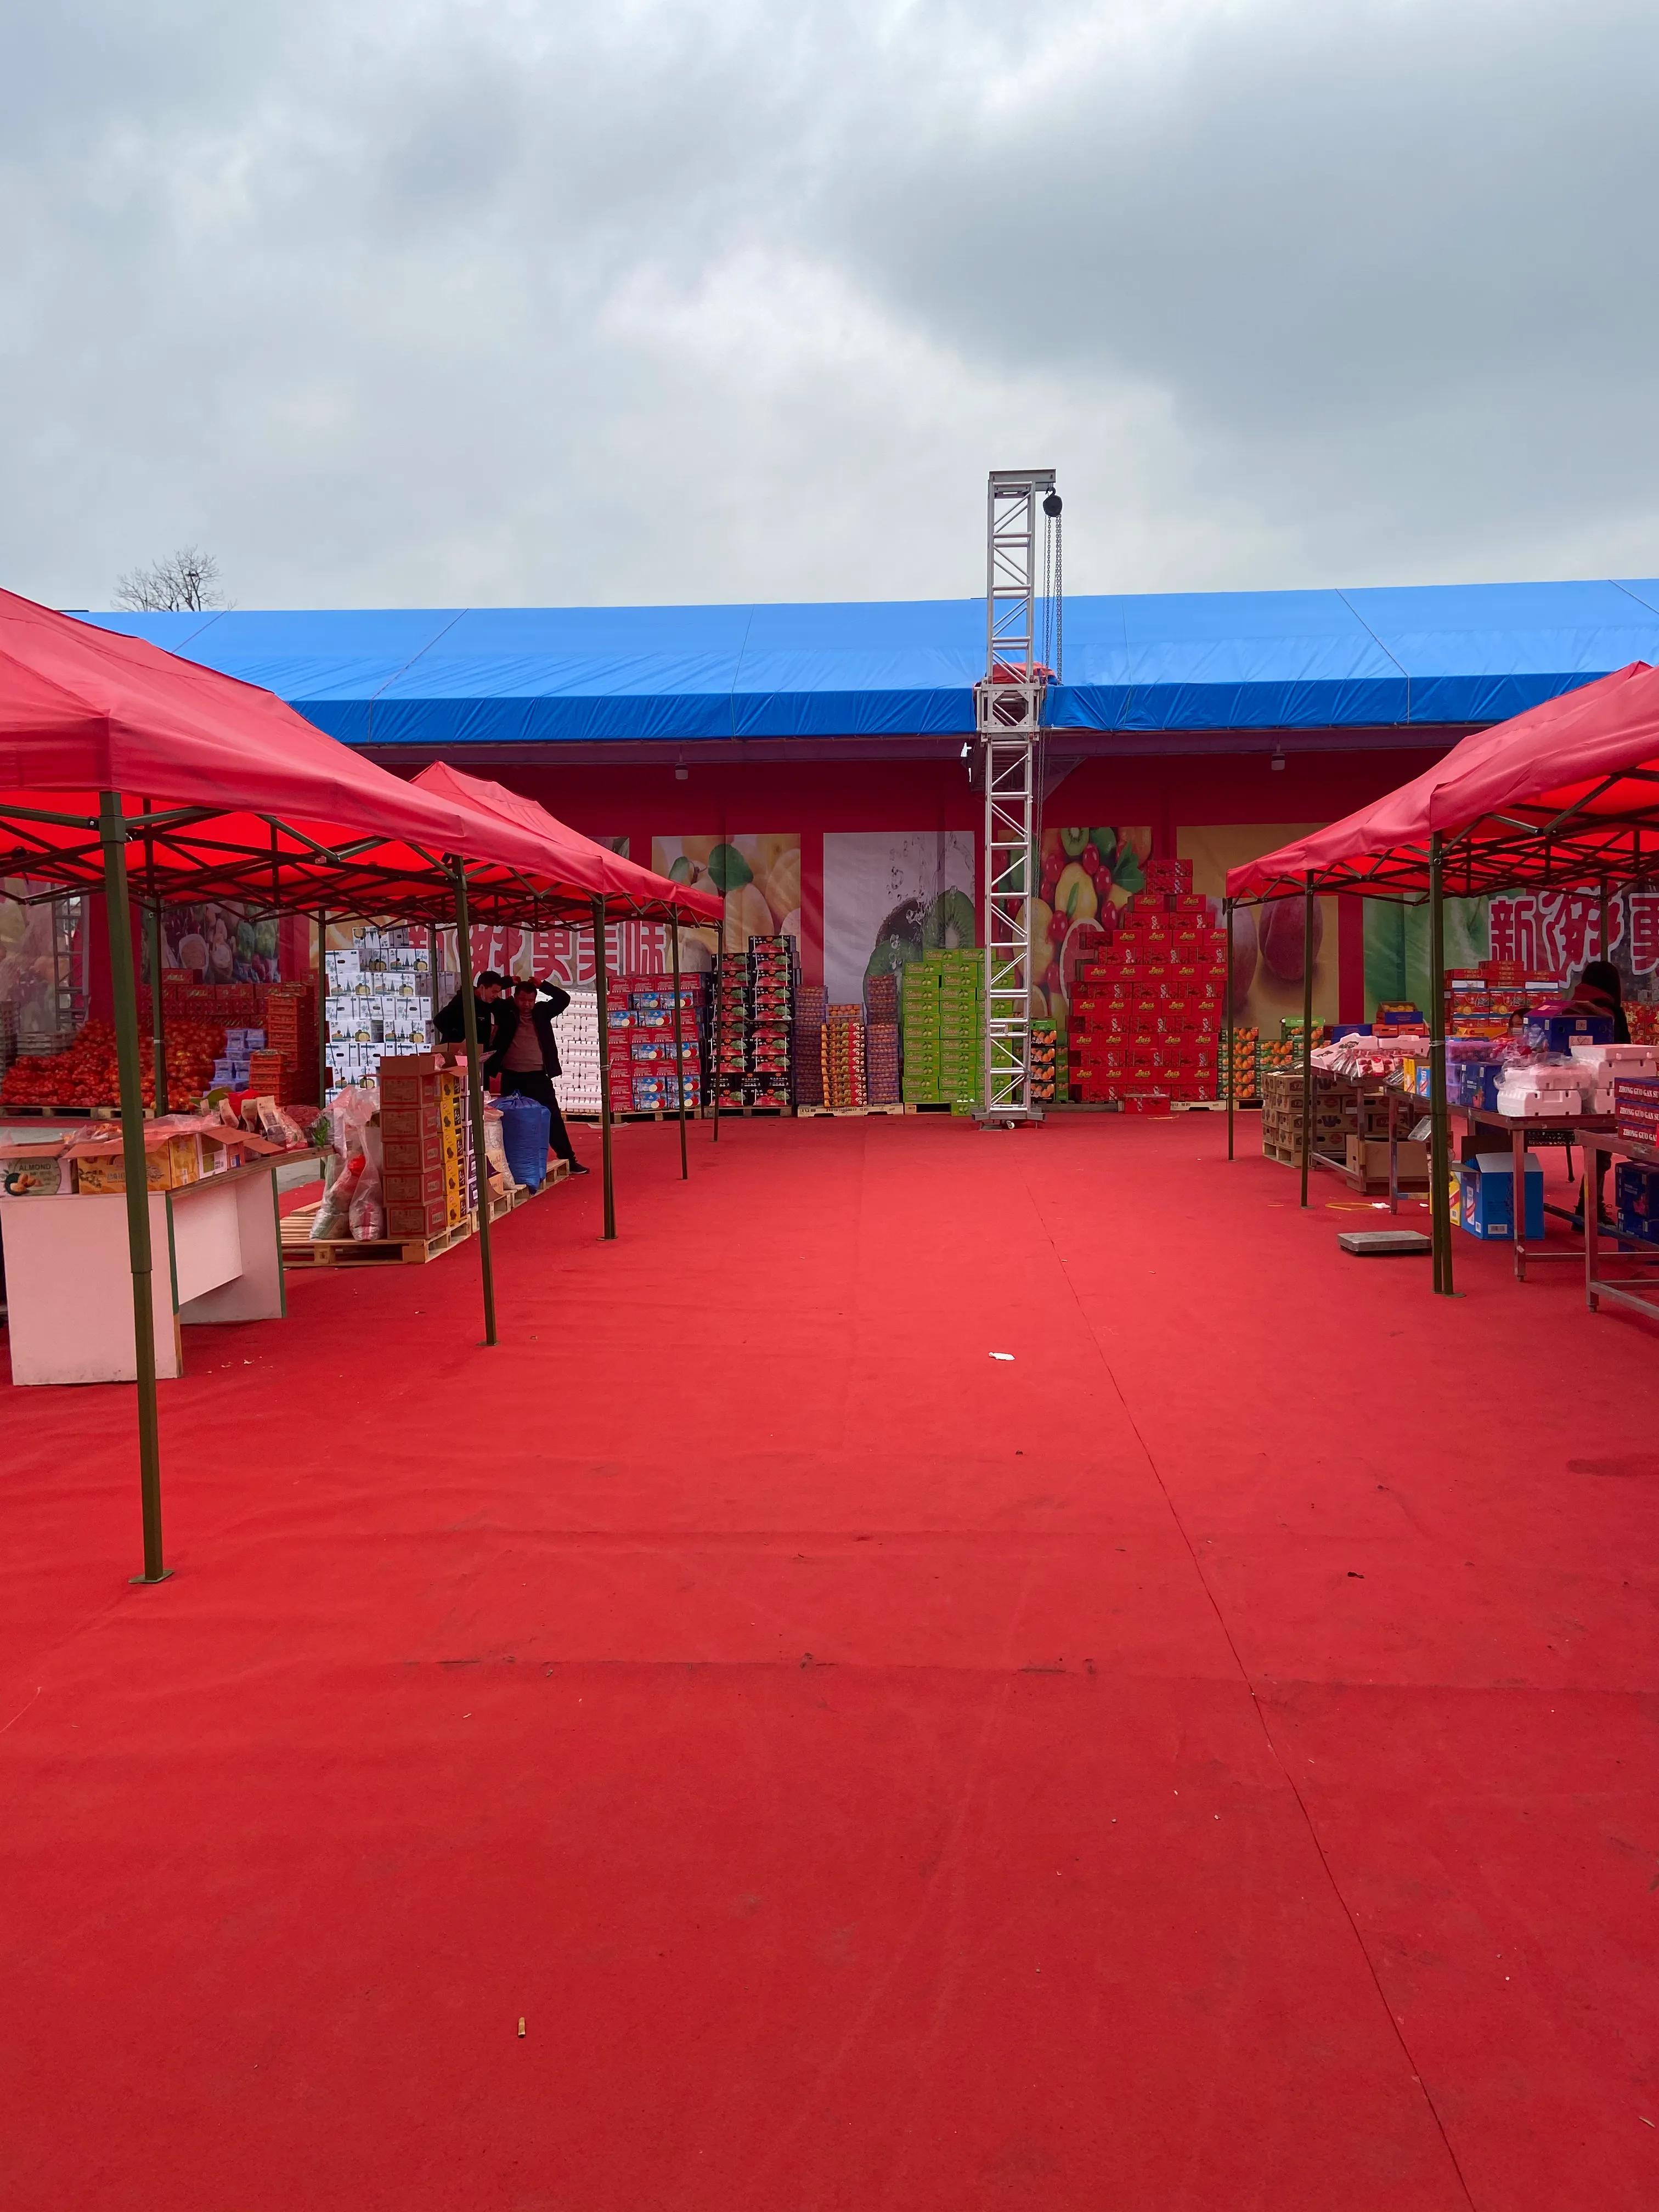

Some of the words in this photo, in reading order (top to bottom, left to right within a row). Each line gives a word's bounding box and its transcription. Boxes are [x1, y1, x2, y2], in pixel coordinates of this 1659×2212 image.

[1619, 1086, 1633, 1094] ZHONG
[1620, 1107, 1634, 1116] ZHONG
[1644, 1111, 1654, 1120] GAN
[1623, 1128, 1638, 1138] ZHONG
